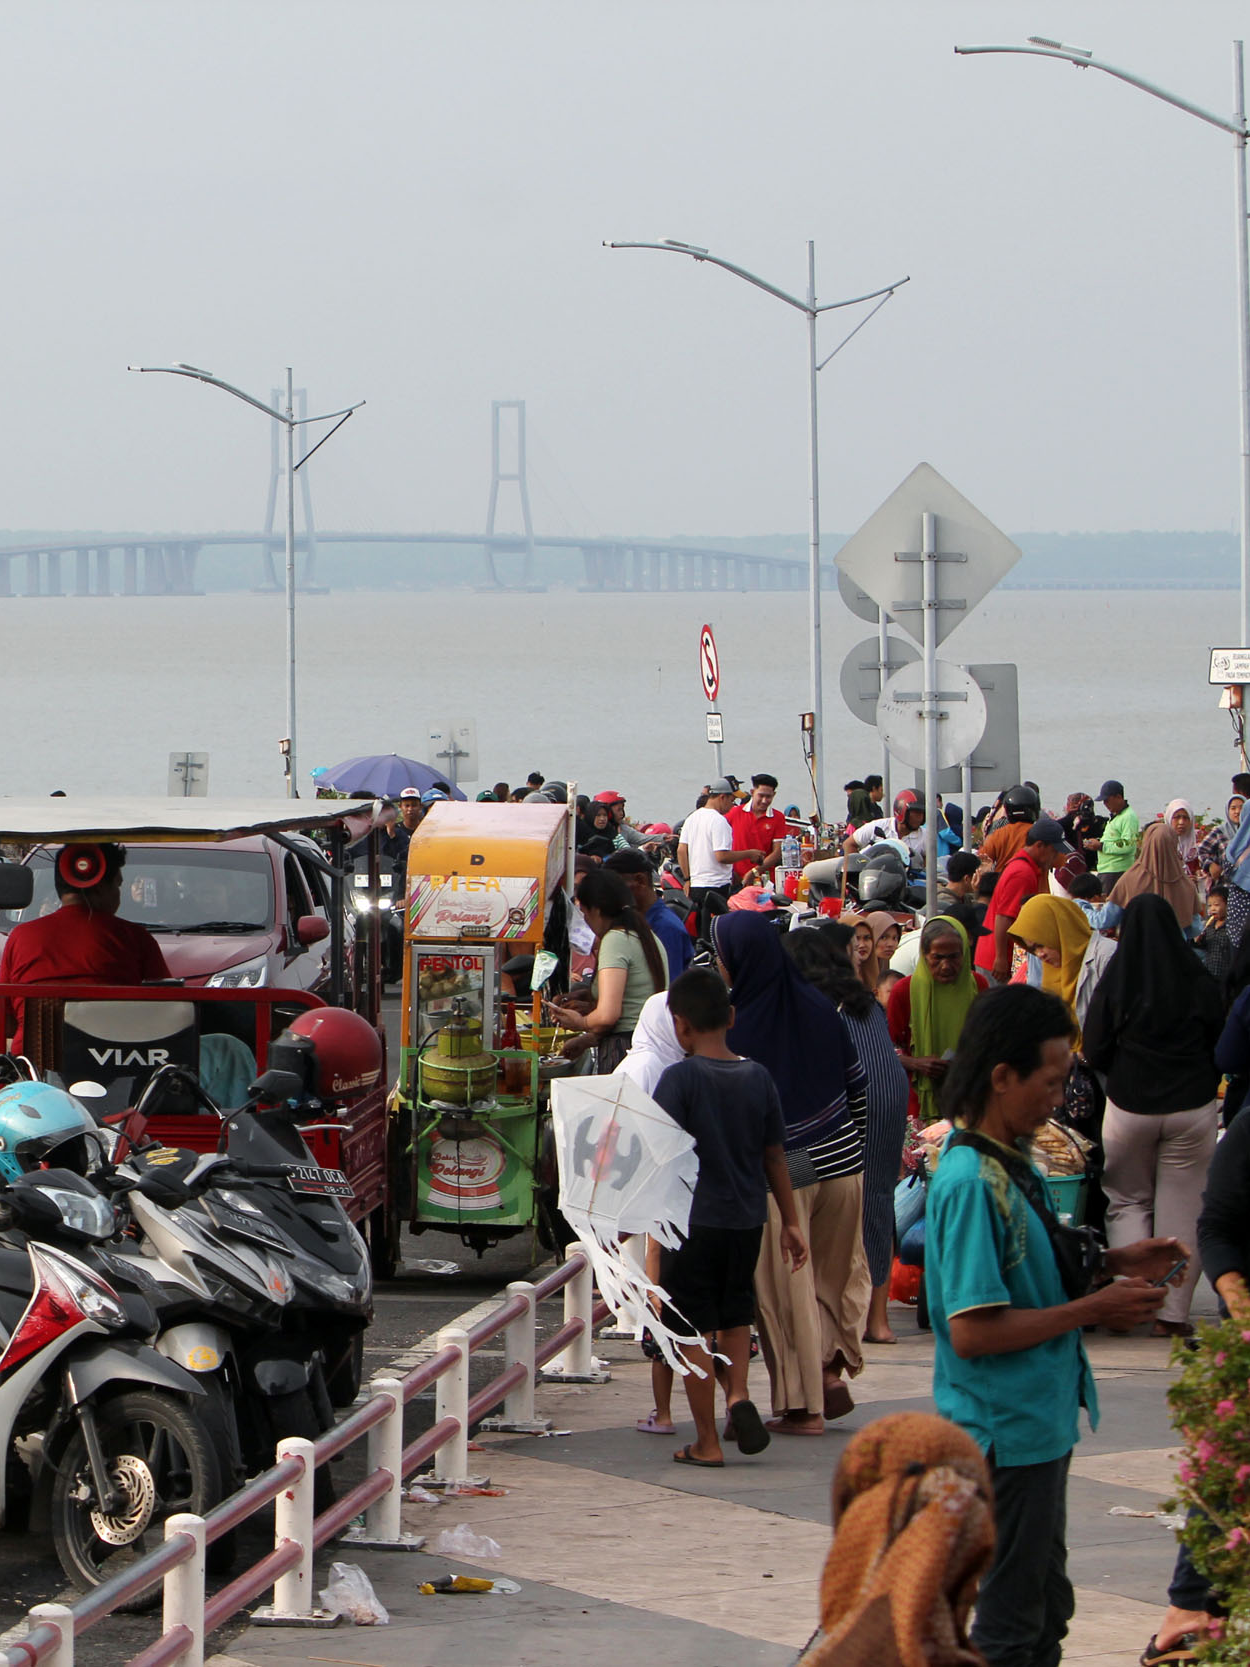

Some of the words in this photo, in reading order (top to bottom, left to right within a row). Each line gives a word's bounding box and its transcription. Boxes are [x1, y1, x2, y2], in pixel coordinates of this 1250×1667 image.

[435, 909, 491, 924] Pelangi
[419, 956, 483, 972] PENTOL
[88, 1048, 170, 1066] VIAR
[332, 1076, 361, 1092] Classic
[296, 1167, 322, 1181] 2147
[429, 1163, 486, 1179] Pelangi
